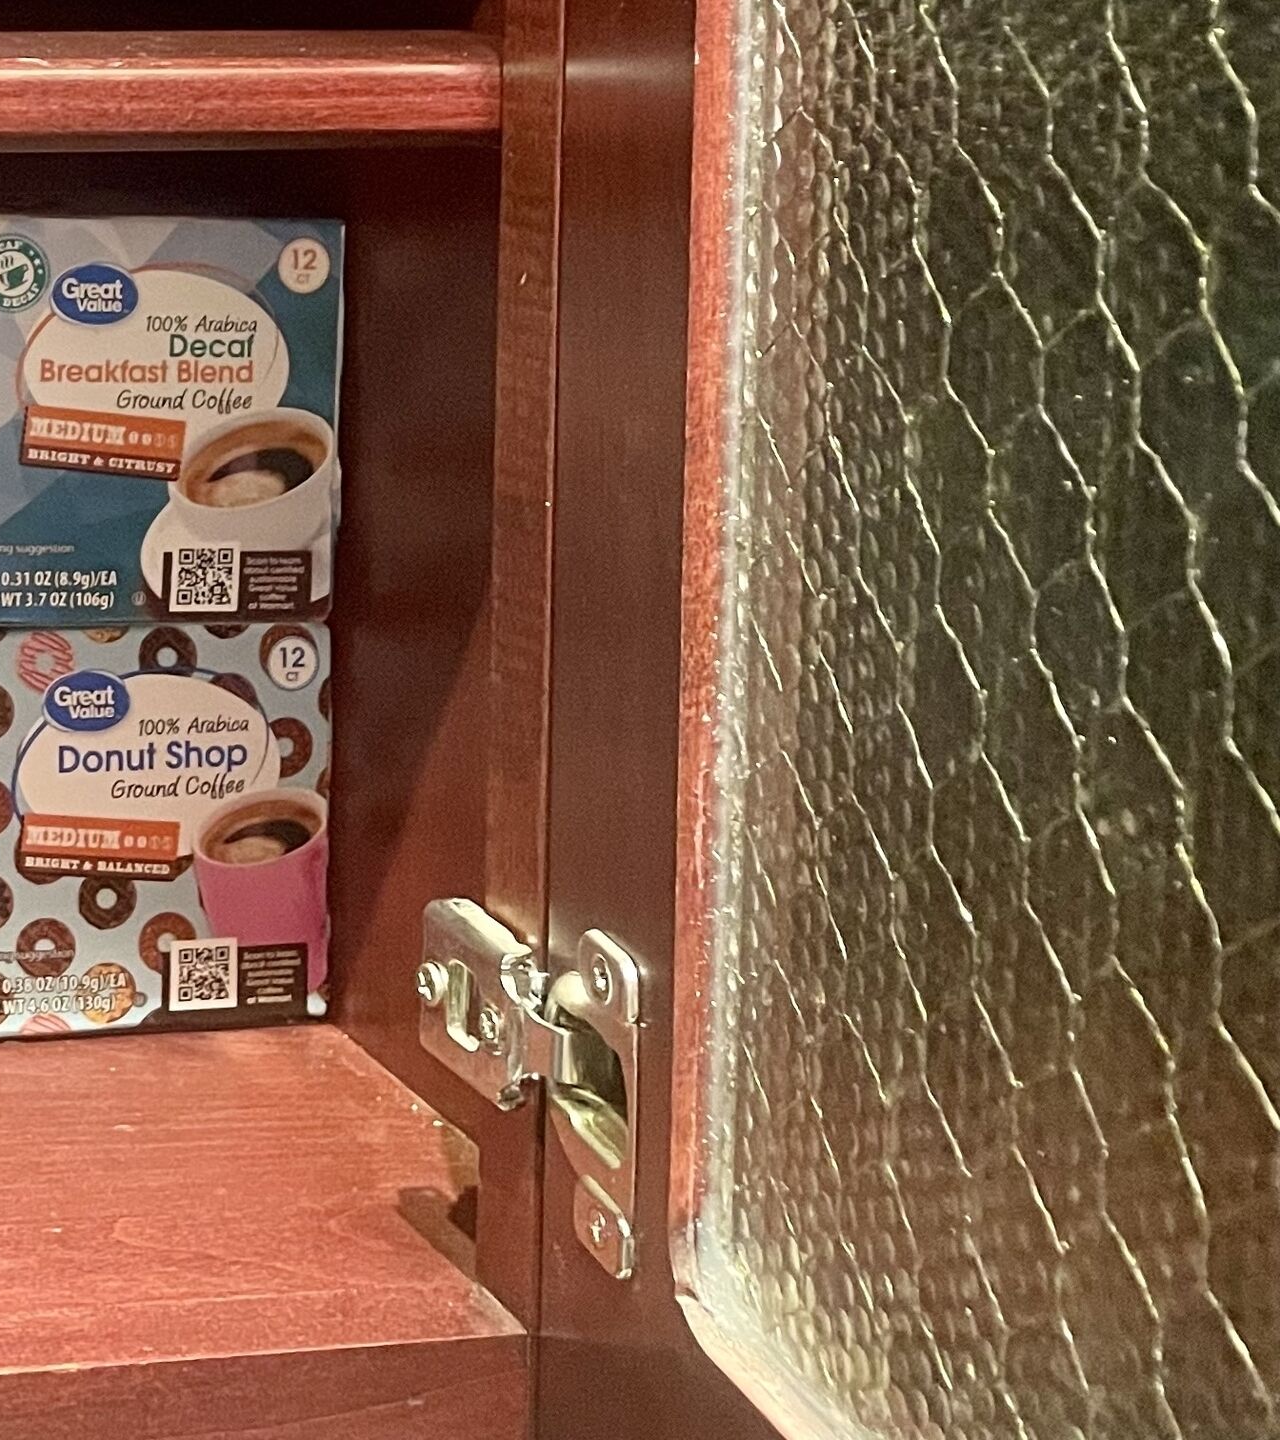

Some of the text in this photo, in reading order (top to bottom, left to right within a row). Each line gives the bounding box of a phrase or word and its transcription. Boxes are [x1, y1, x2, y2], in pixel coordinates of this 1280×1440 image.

[292, 250, 318, 270] 12
[3, 283, 40, 307] DECAF
[62, 278, 123, 300] Great
[76, 298, 123, 312] Value
[146, 315, 257, 333] 100% Arabica
[170, 334, 255, 357] Decaf
[40, 359, 254, 383] Breakfast Blend
[117, 389, 252, 413] Ground Coffee
[30, 417, 126, 445] MEDIUM
[28, 448, 175, 474] BRIGHT & CITRUSY
[1, 572, 30, 586] 0.31
[34, 571, 51, 586] OZ
[1, 592, 22, 606] WT
[25, 592, 47, 606] 3.7
[50, 592, 67, 606] OZ
[70, 591, 114, 610] (106g)
[280, 647, 305, 668] 12
[54, 686, 115, 706] Great
[69, 707, 115, 719] Value
[139, 716, 249, 736] 100% Arabica
[58, 741, 248, 773] Donut Shop
[112, 774, 245, 798] Ground Coffee
[26, 827, 121, 848] MEDIUM
[24, 856, 170, 874] BRIGHT & BALANCED
[36, 977, 52, 992] OZ
[3, 999, 24, 1014] WT
[27, 998, 49, 1013] 4.6
[52, 996, 70, 1011] OZ
